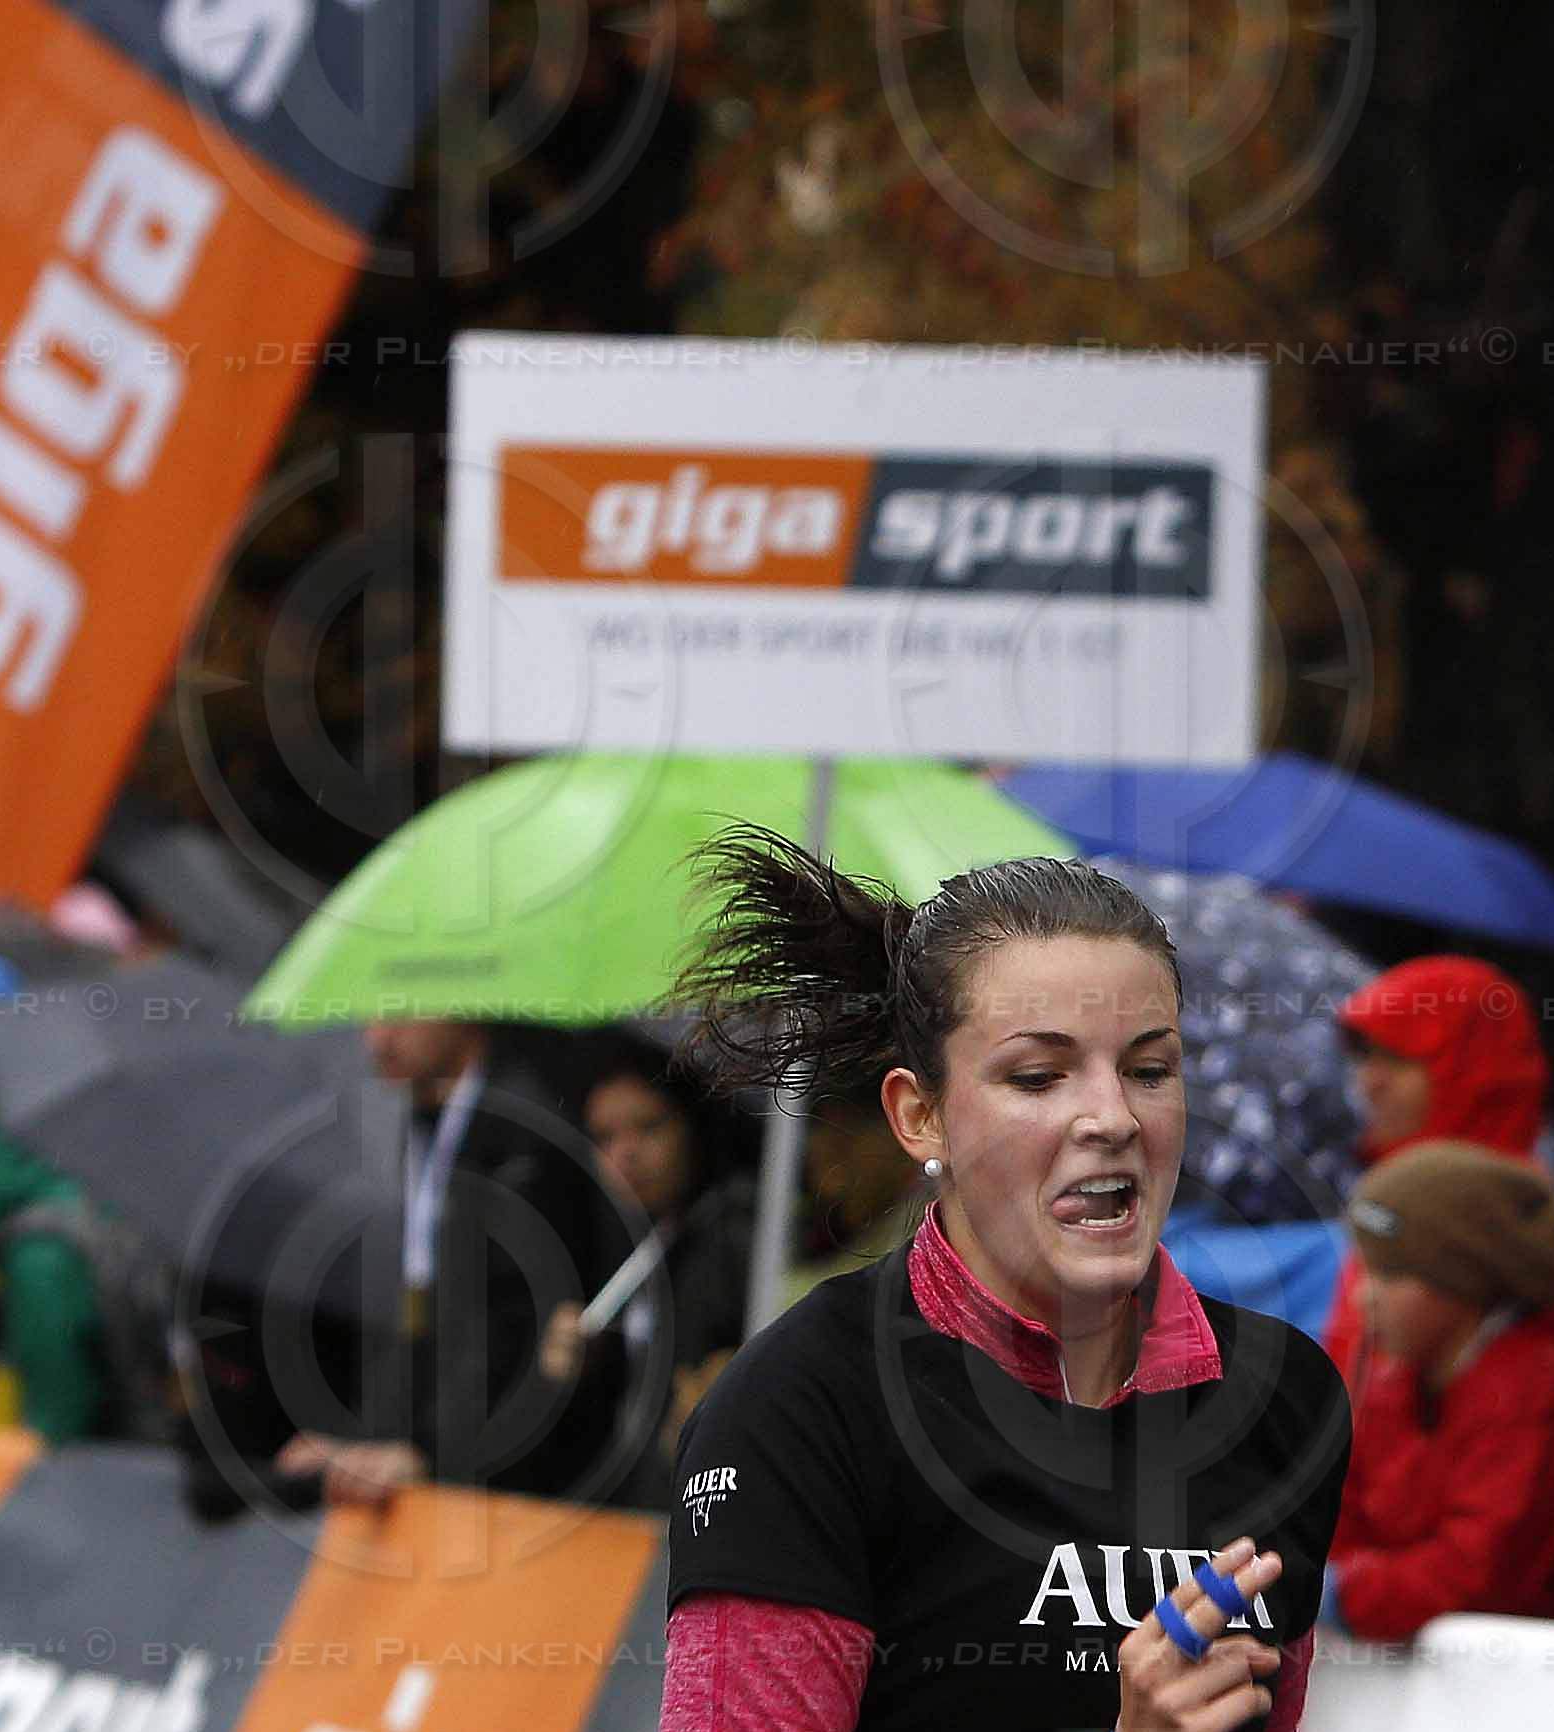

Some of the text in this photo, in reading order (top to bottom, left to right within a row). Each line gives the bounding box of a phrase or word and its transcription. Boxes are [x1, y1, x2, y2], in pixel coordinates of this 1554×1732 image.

[581, 466, 1187, 580] giga sport
[682, 1466, 738, 1502] AUER
